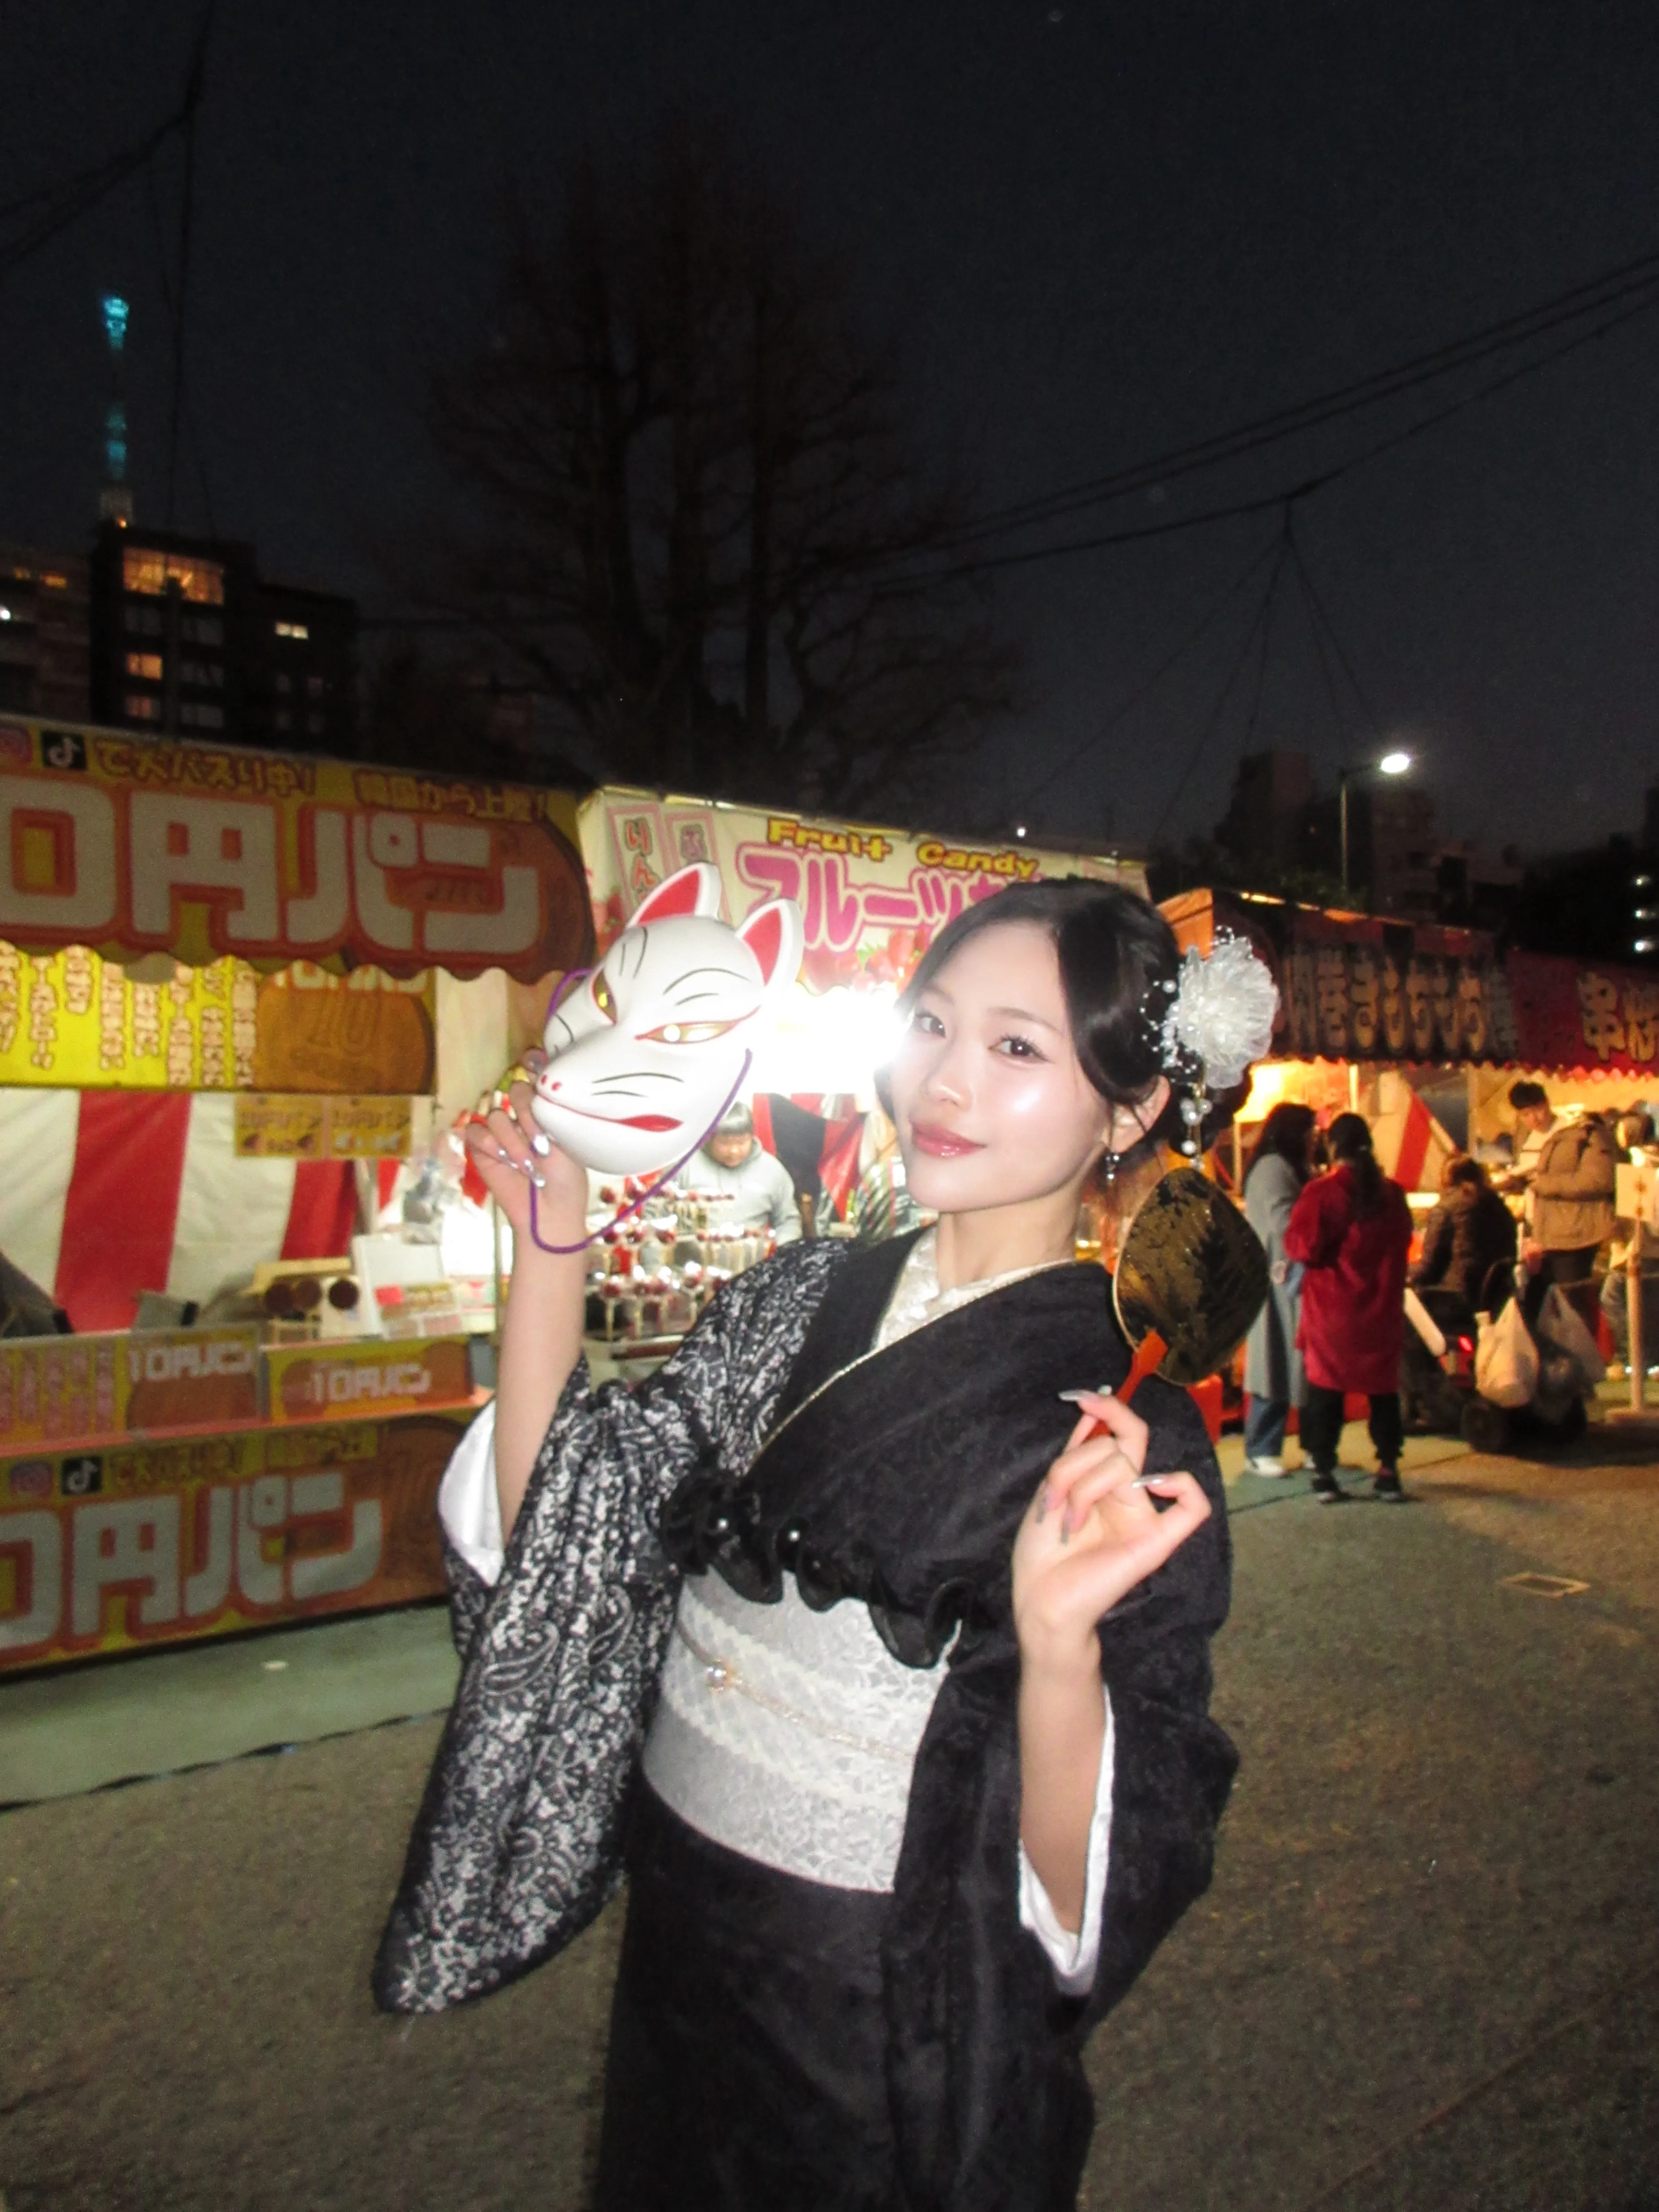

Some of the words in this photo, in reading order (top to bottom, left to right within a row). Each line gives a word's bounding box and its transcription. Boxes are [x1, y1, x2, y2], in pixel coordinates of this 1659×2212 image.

[624, 816, 660, 902] りん
[767, 818, 893, 862] Fruit
[916, 840, 1039, 879] Candy
